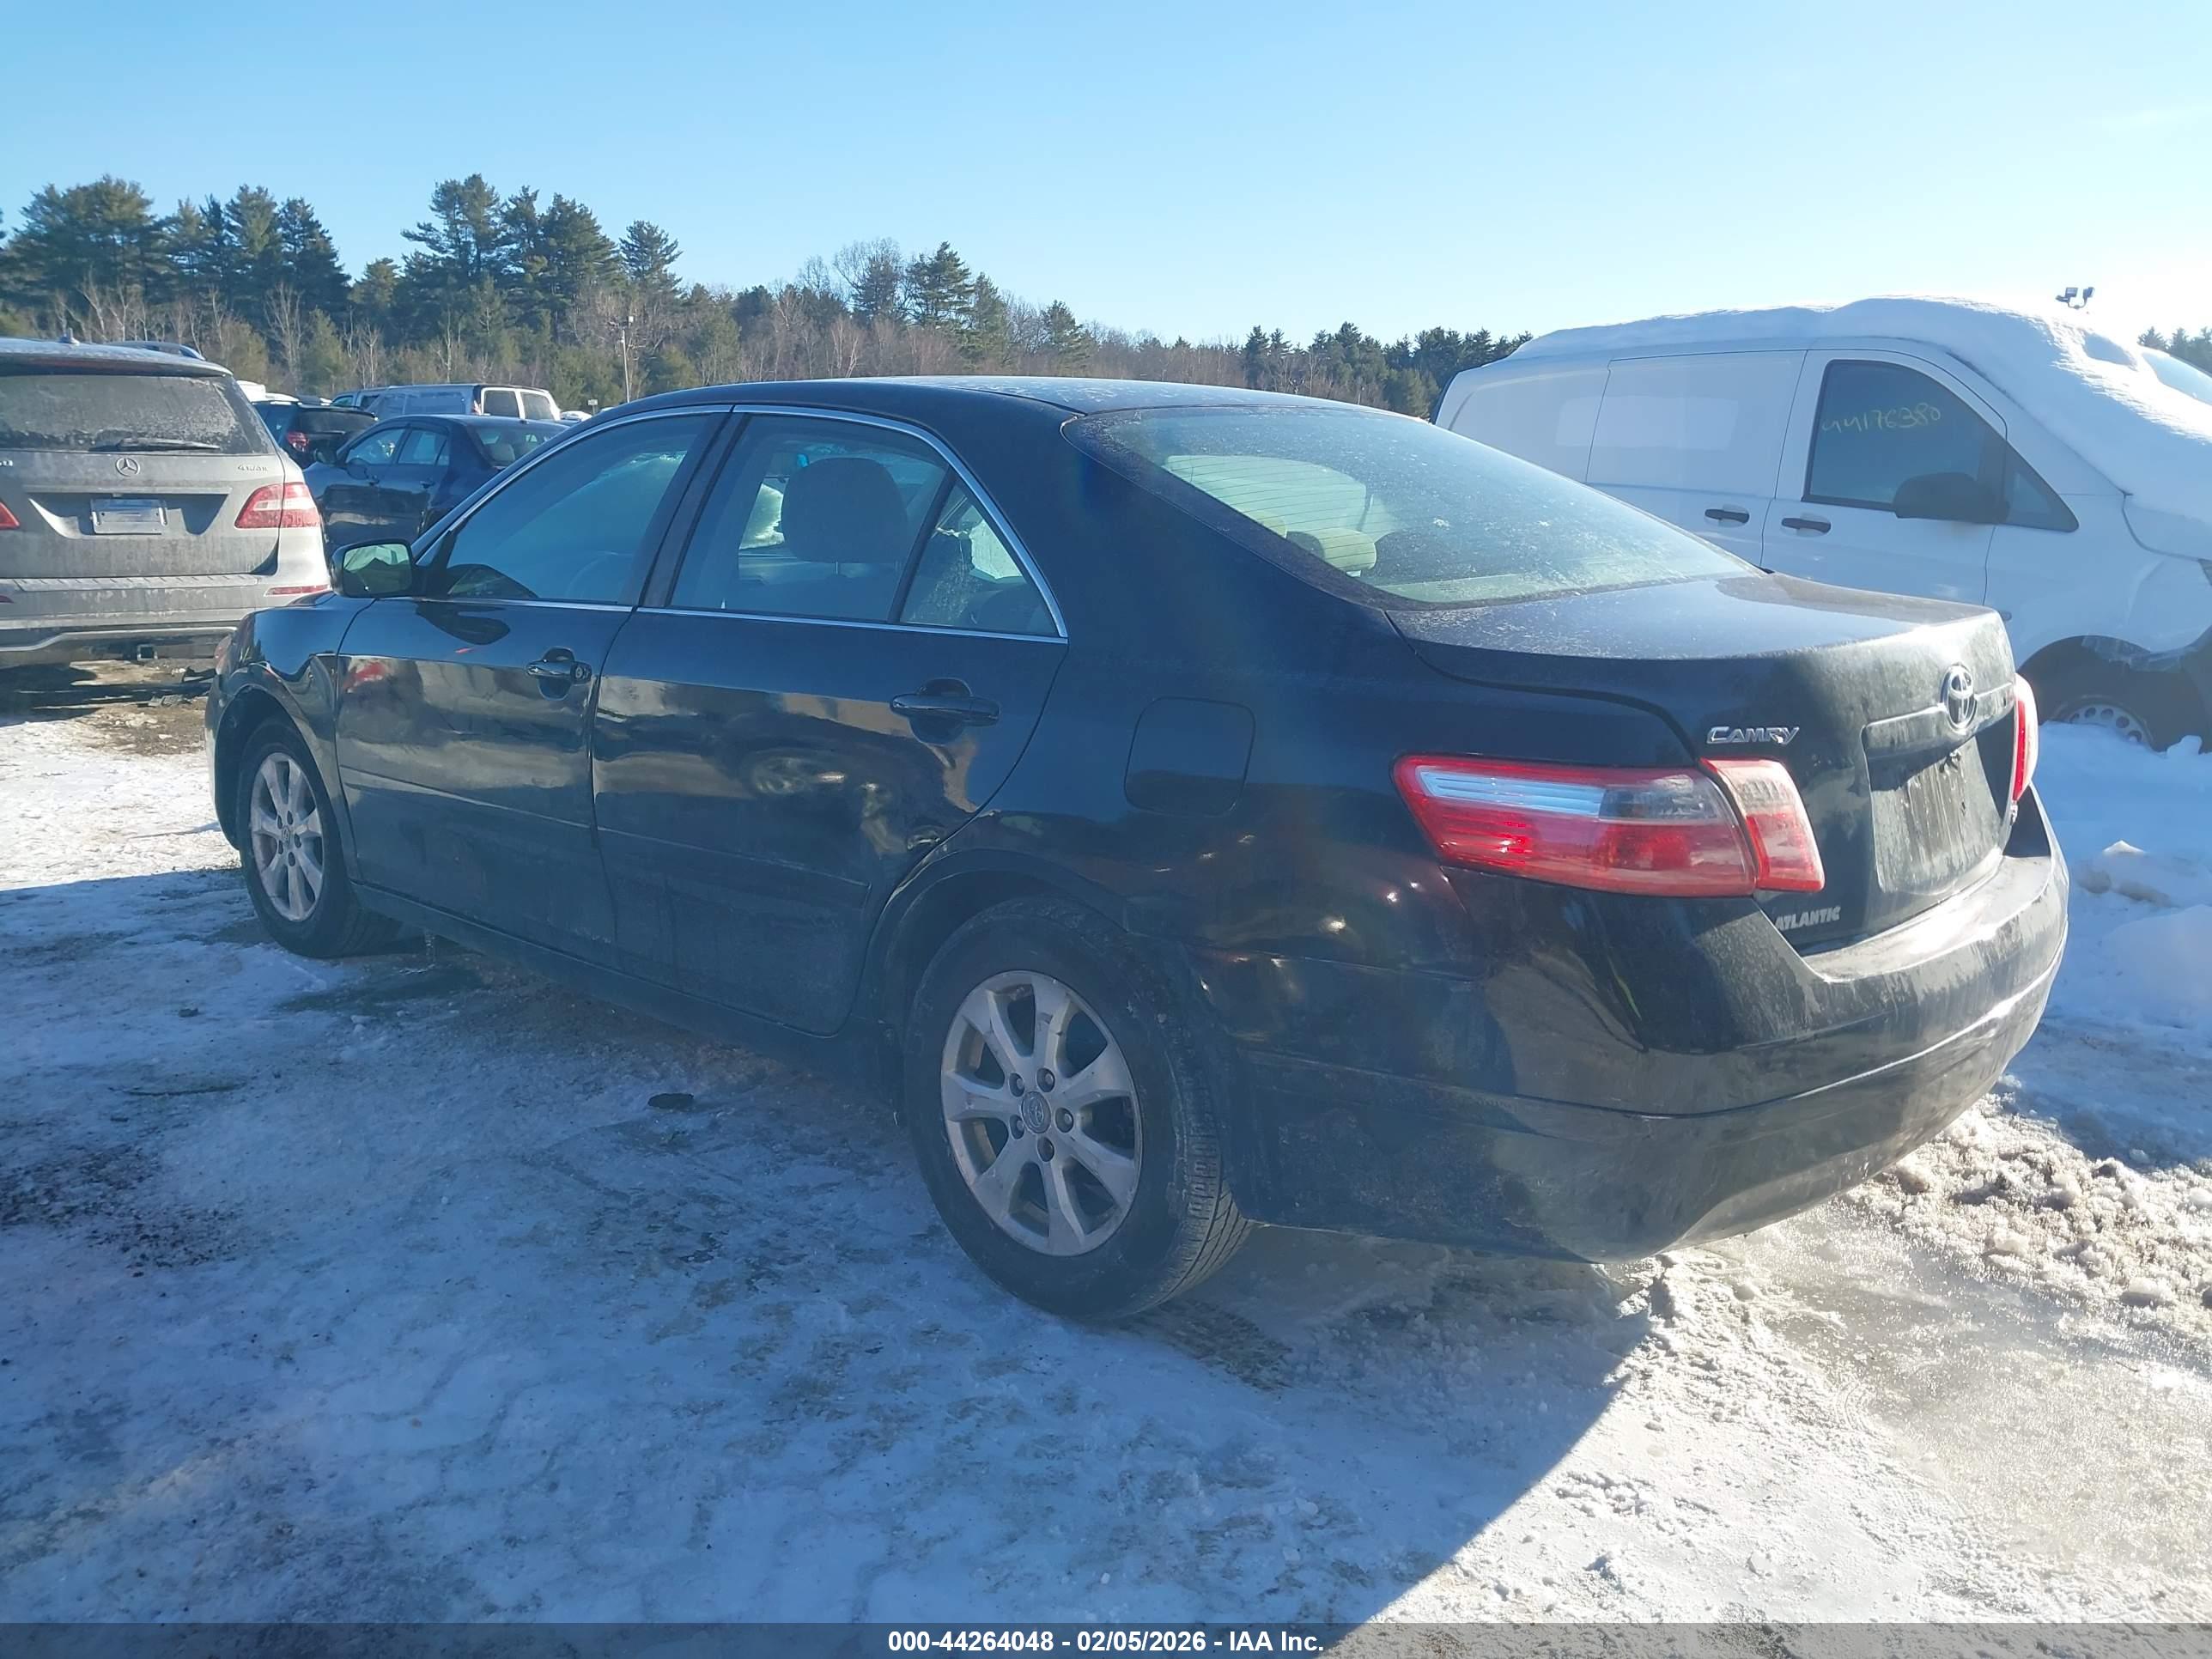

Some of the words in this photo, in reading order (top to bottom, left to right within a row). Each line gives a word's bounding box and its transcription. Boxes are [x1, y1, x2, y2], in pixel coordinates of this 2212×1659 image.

[1821, 402, 1942, 433] 44176380
[1706, 726, 1800, 745] CAMRY
[1774, 905, 1841, 931] ATLANTIC
